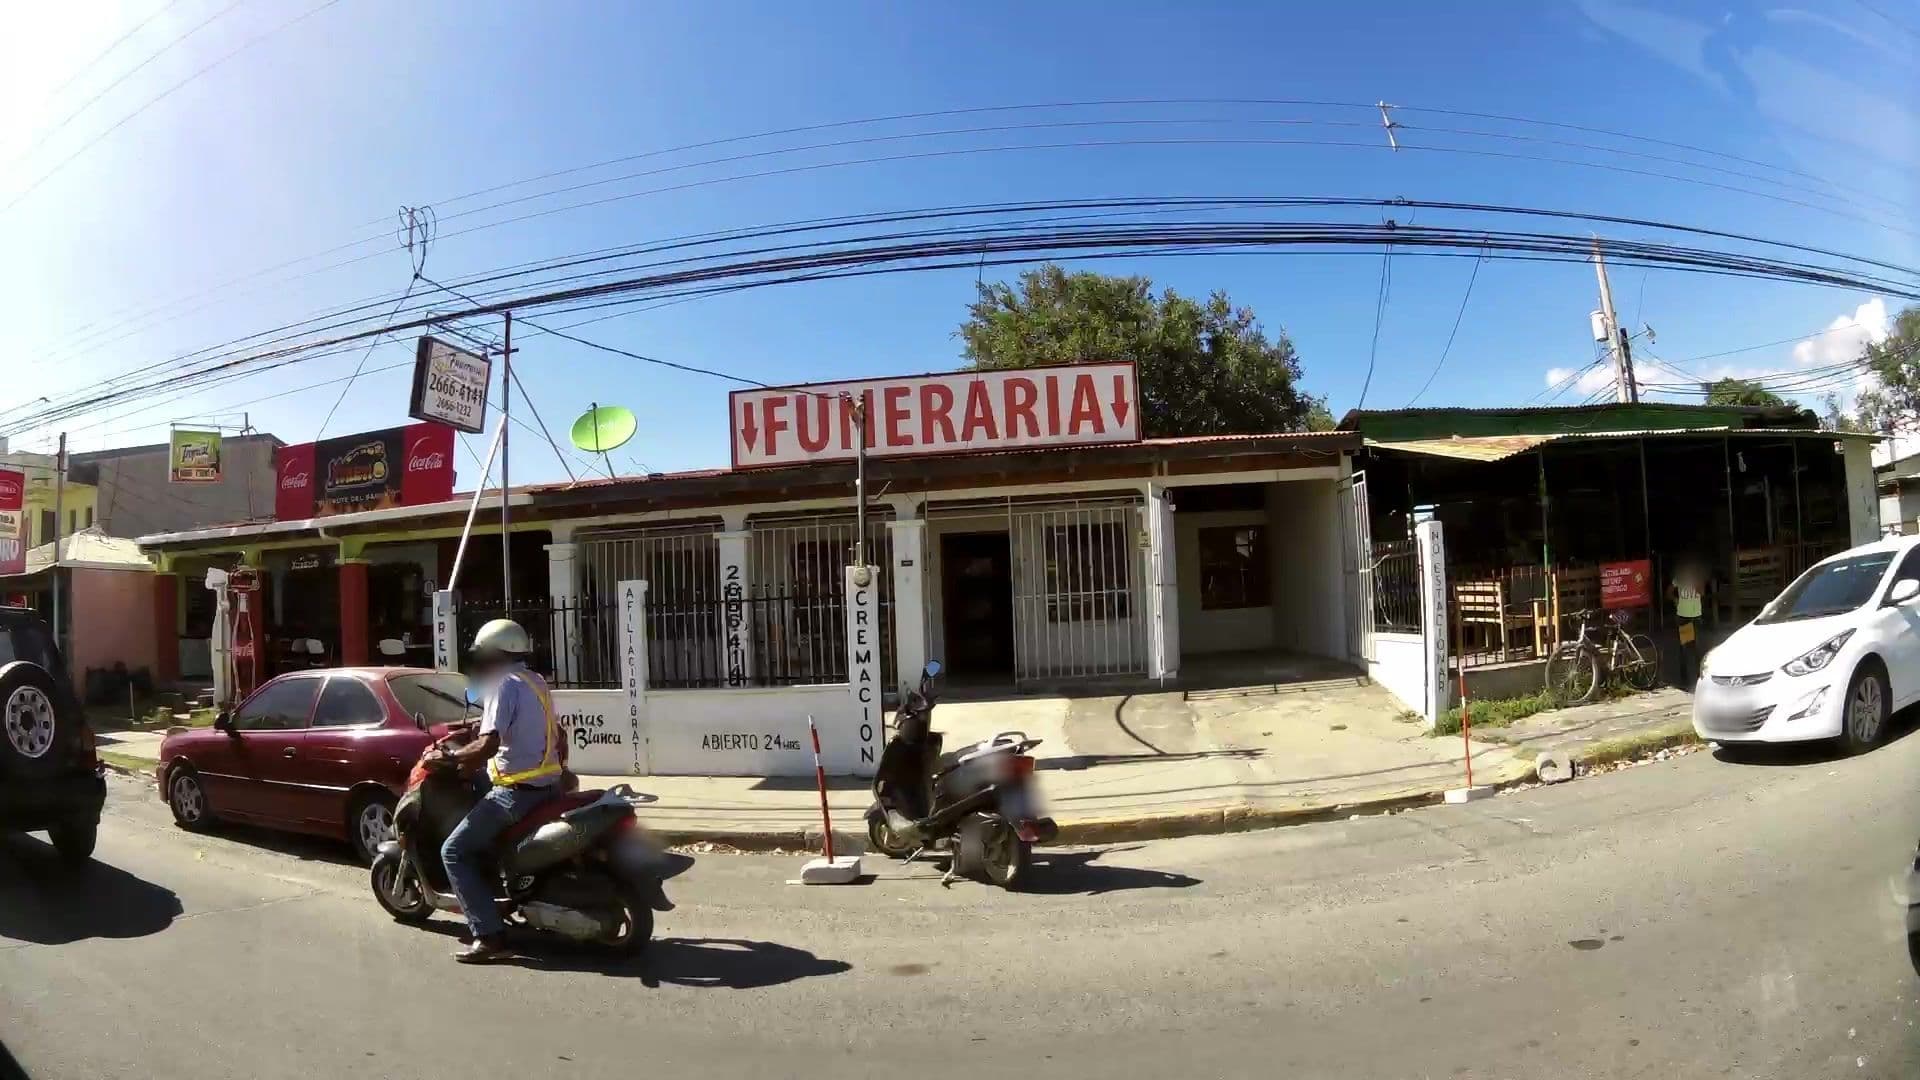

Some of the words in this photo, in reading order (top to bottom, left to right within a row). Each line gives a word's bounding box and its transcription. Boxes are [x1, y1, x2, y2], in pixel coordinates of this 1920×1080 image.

[763, 374, 1105, 456] FUNERARIA
[1431, 531, 1440, 555] NO
[1433, 563, 1445, 692] ESTACIONAR
[855, 590, 874, 763] CREMACION
[573, 727, 622, 750] Blanca
[630, 704, 641, 775] GRATIS
[702, 734, 758, 751] ABIERTO
